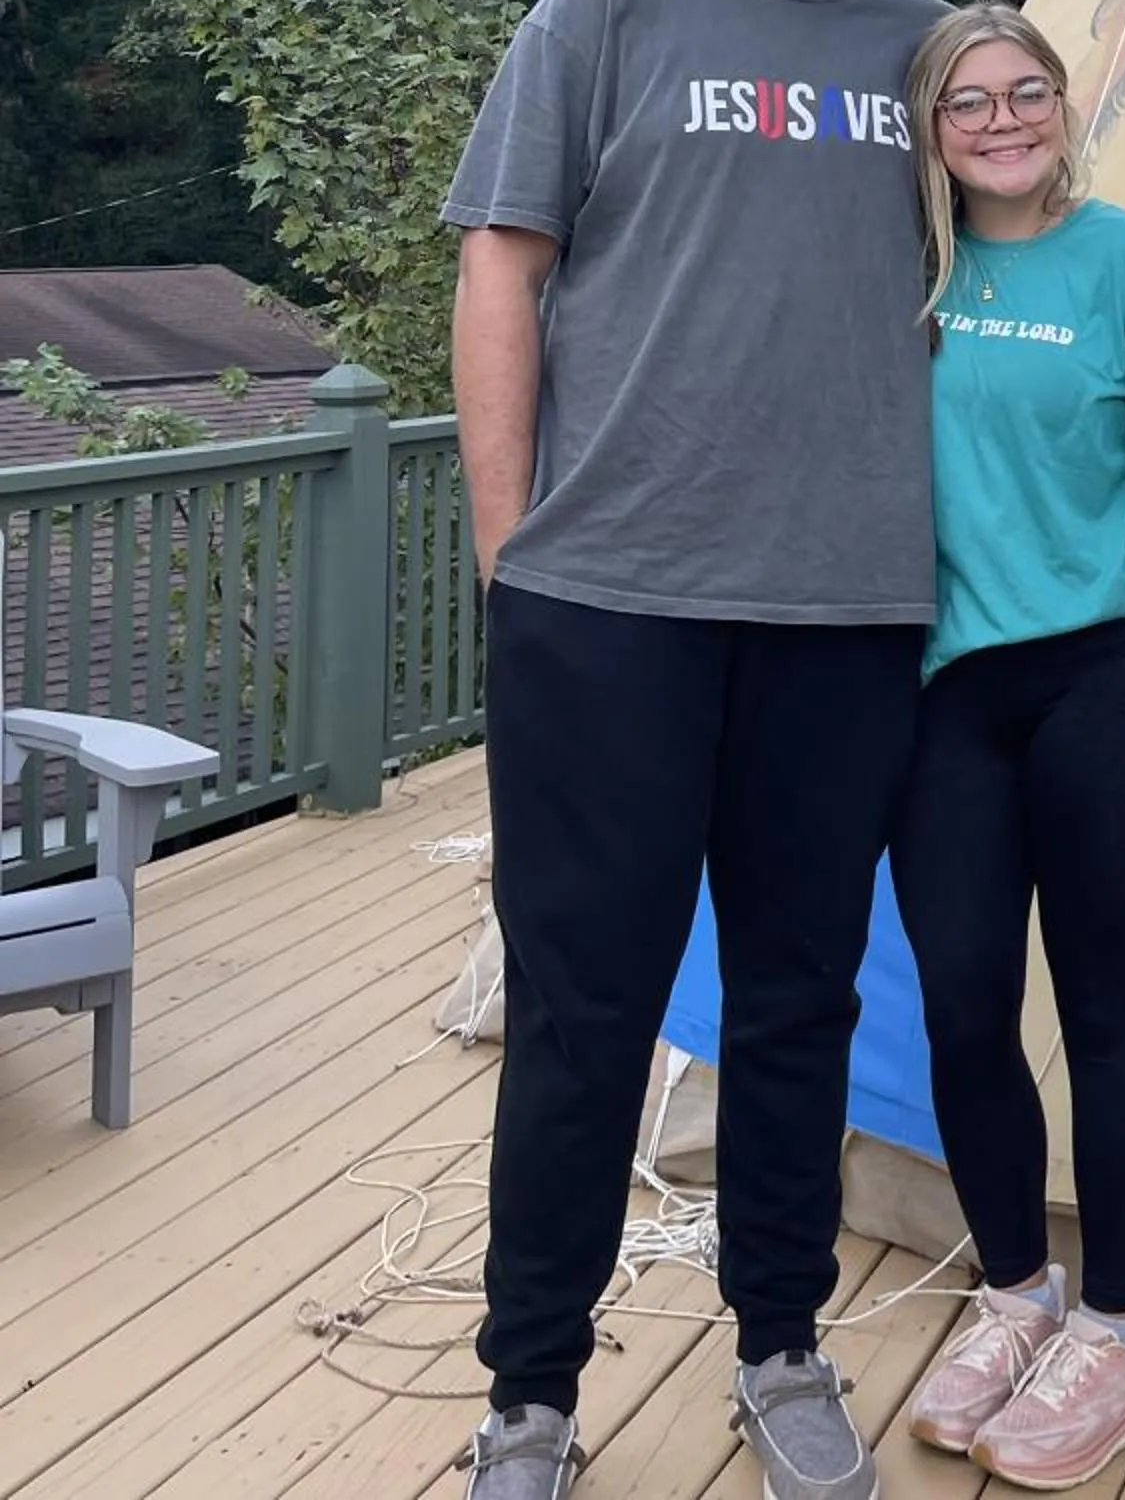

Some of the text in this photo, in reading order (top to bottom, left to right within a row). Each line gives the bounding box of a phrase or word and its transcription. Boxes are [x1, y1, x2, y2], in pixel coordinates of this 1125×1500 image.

[950, 313, 977, 333] IN
[979, 318, 1014, 337] THE
[1016, 321, 1074, 345] LORD
